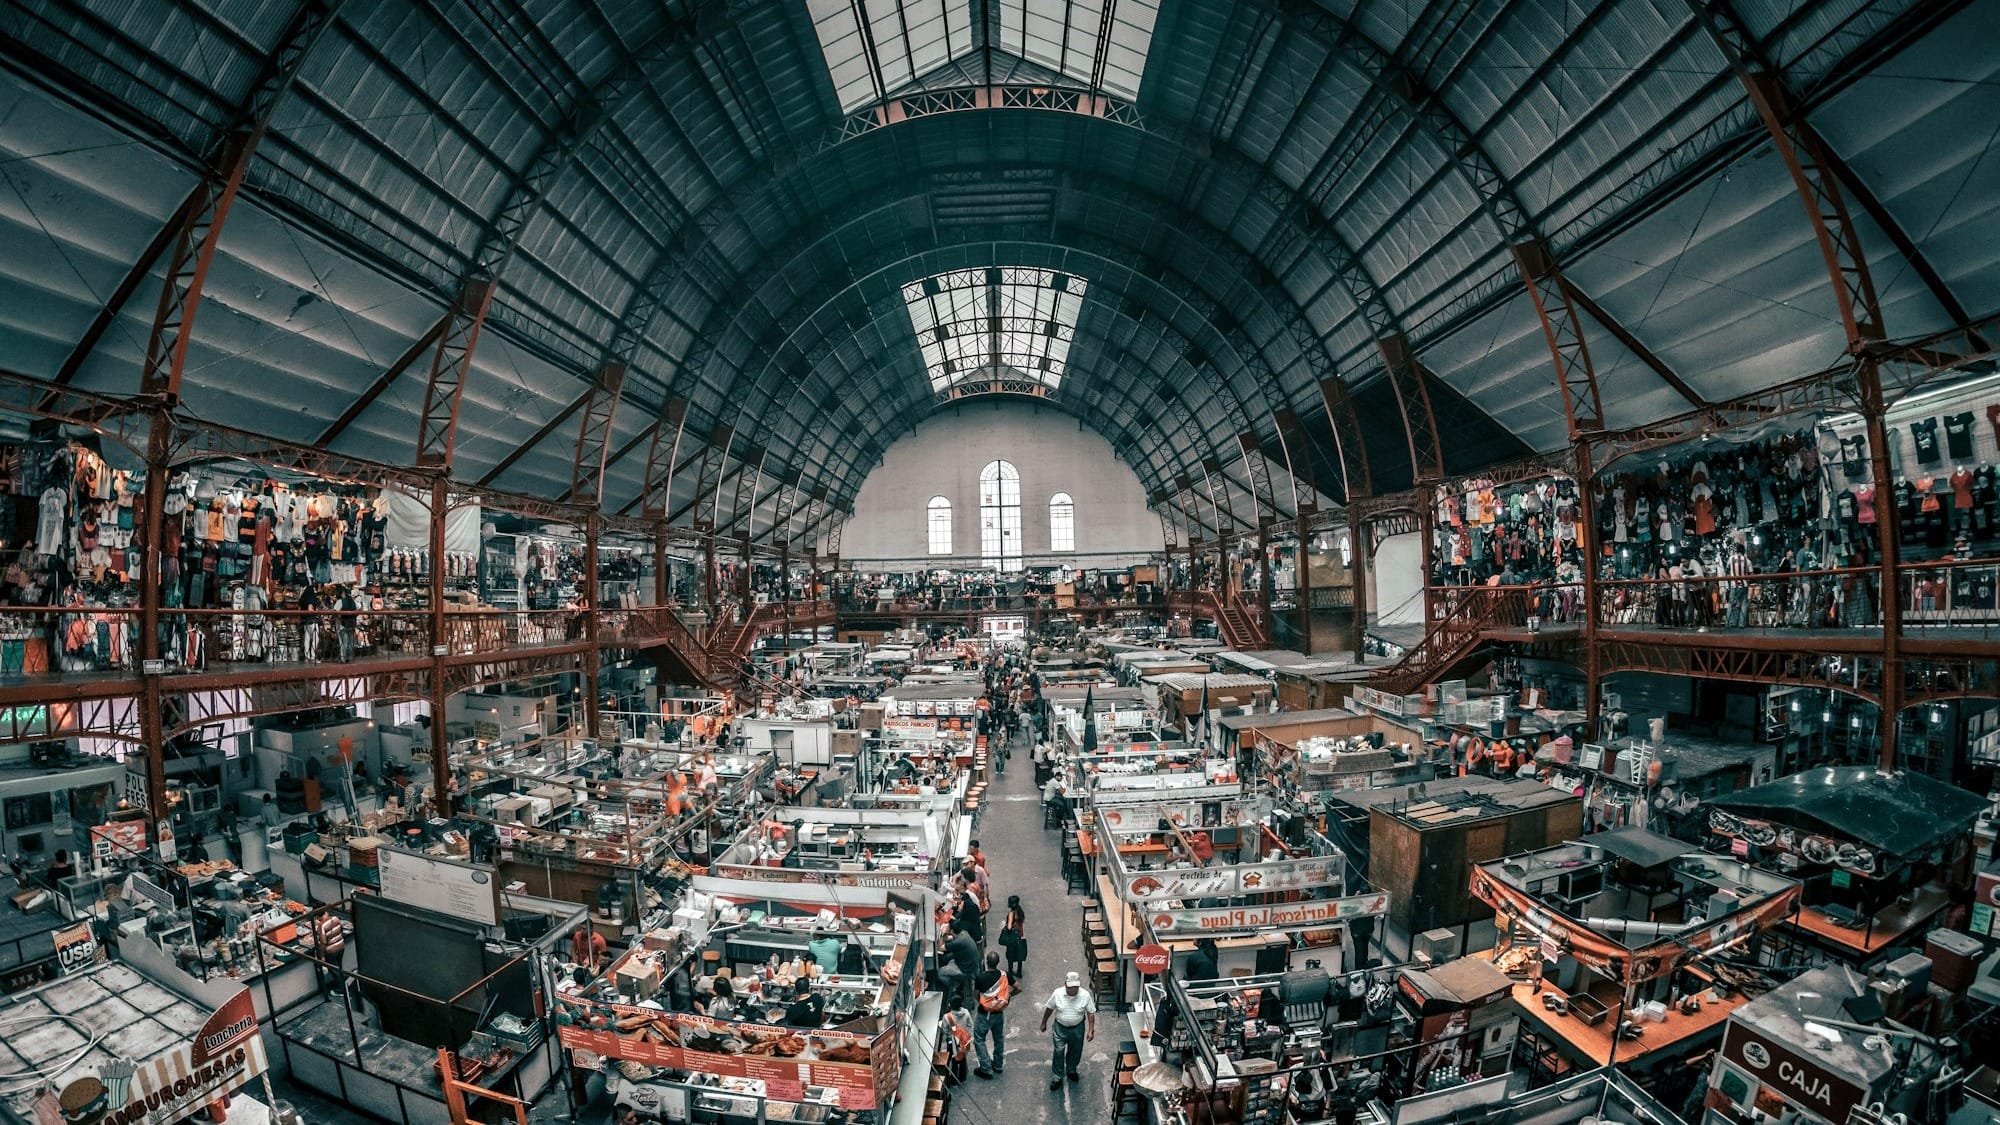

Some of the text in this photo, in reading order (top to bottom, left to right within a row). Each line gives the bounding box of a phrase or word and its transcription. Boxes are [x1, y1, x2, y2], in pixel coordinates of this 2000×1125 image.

[859, 877, 912, 888] Antojitos
[62, 941, 94, 966] USB
[741, 1024, 786, 1034] PECHUGAS
[812, 1030, 852, 1038] COMIDAS
[95, 1047, 247, 1125] AMBURGUESAS
[1778, 1061, 1831, 1106] CAJA
